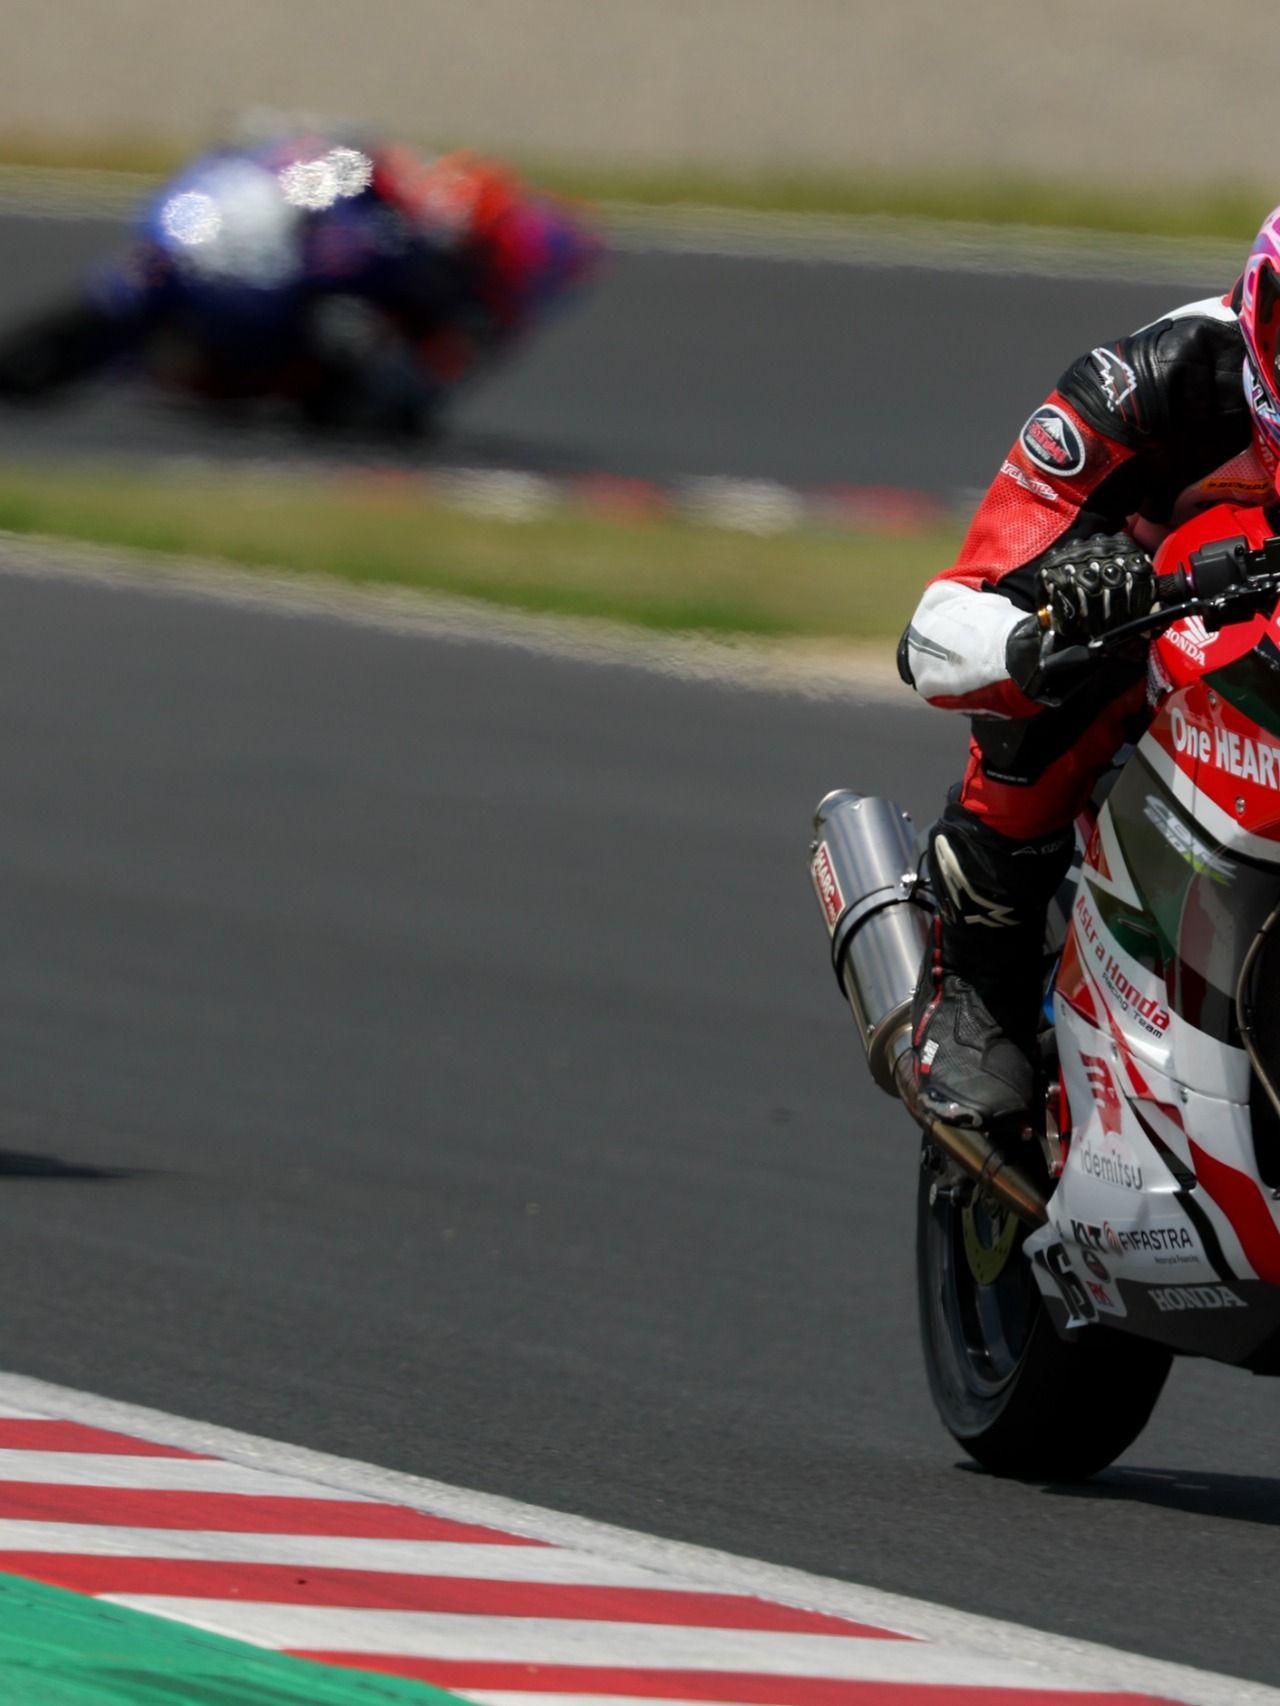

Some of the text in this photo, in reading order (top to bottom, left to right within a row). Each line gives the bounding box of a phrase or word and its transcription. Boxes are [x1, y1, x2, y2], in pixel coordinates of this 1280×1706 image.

[1169, 706, 1211, 764] One
[1075, 895, 1171, 1031] Astra Honda
[1133, 1012, 1164, 1039] Team
[1080, 1140, 1144, 1190] idemitsu
[1147, 1285, 1249, 1312] HONDA
